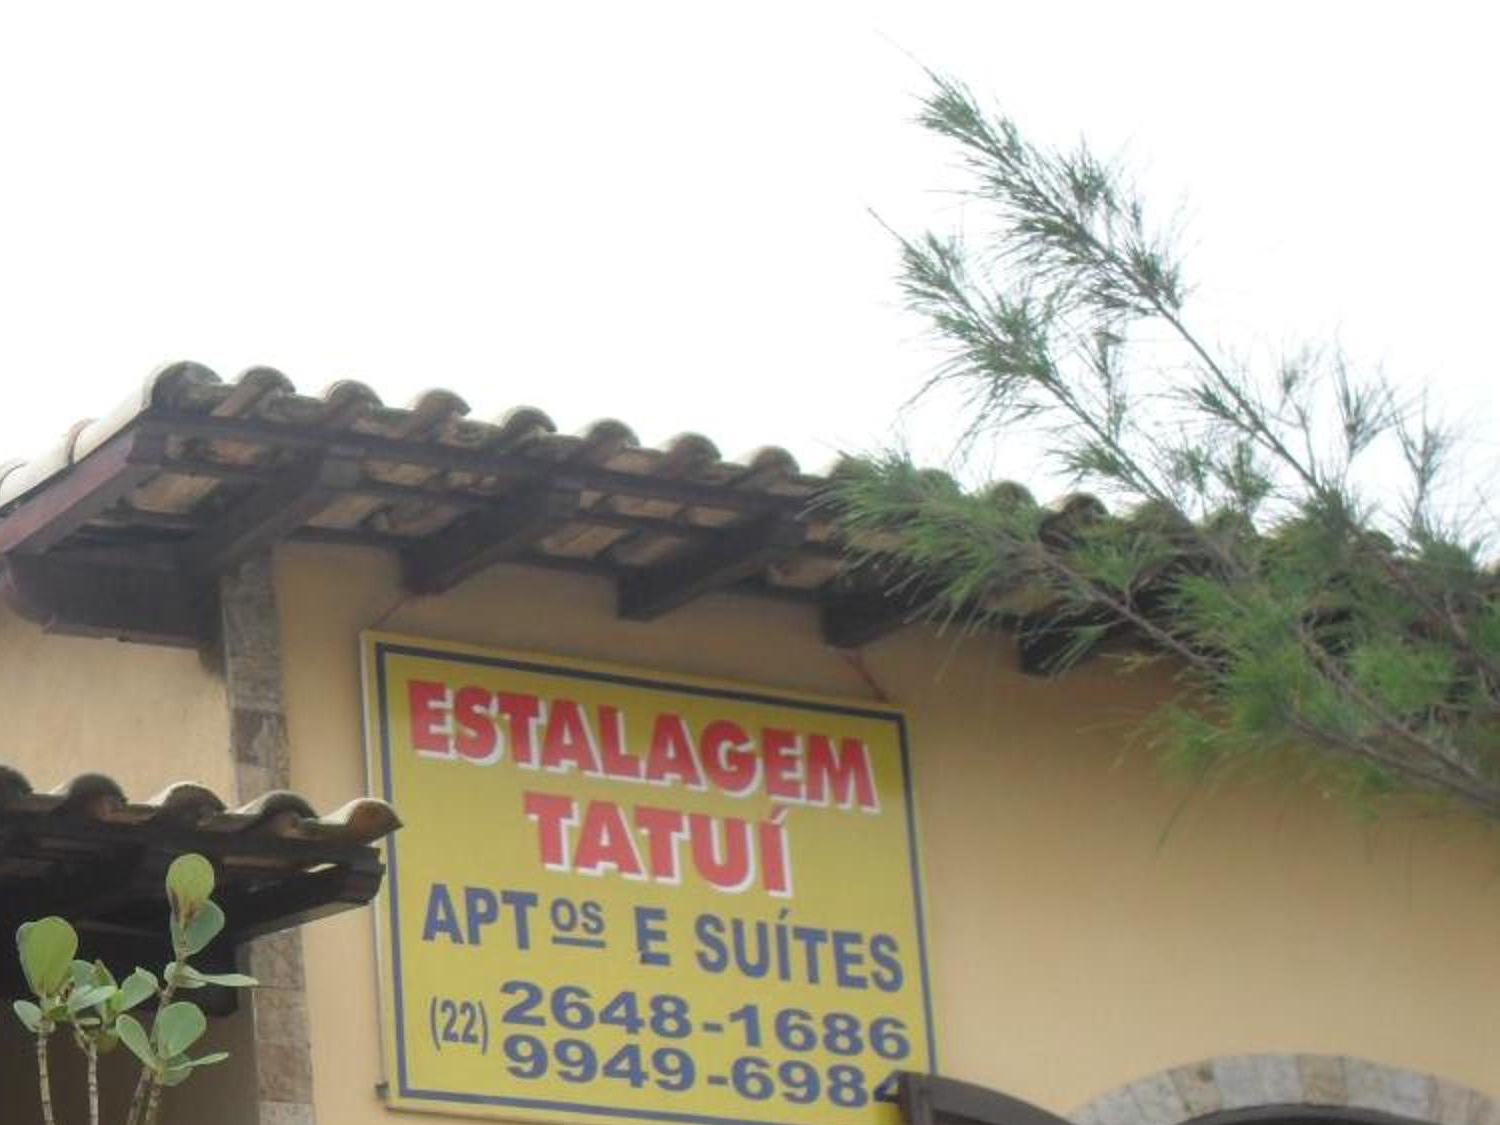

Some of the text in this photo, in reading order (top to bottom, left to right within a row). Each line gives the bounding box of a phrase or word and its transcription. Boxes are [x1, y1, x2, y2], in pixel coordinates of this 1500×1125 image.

[406, 679, 881, 813] ESTALAGEM
[523, 790, 793, 897] TATUÍ
[634, 905, 671, 966] E
[694, 908, 904, 993] SUÍTES
[430, 980, 911, 1061] (22) 2648-1686
